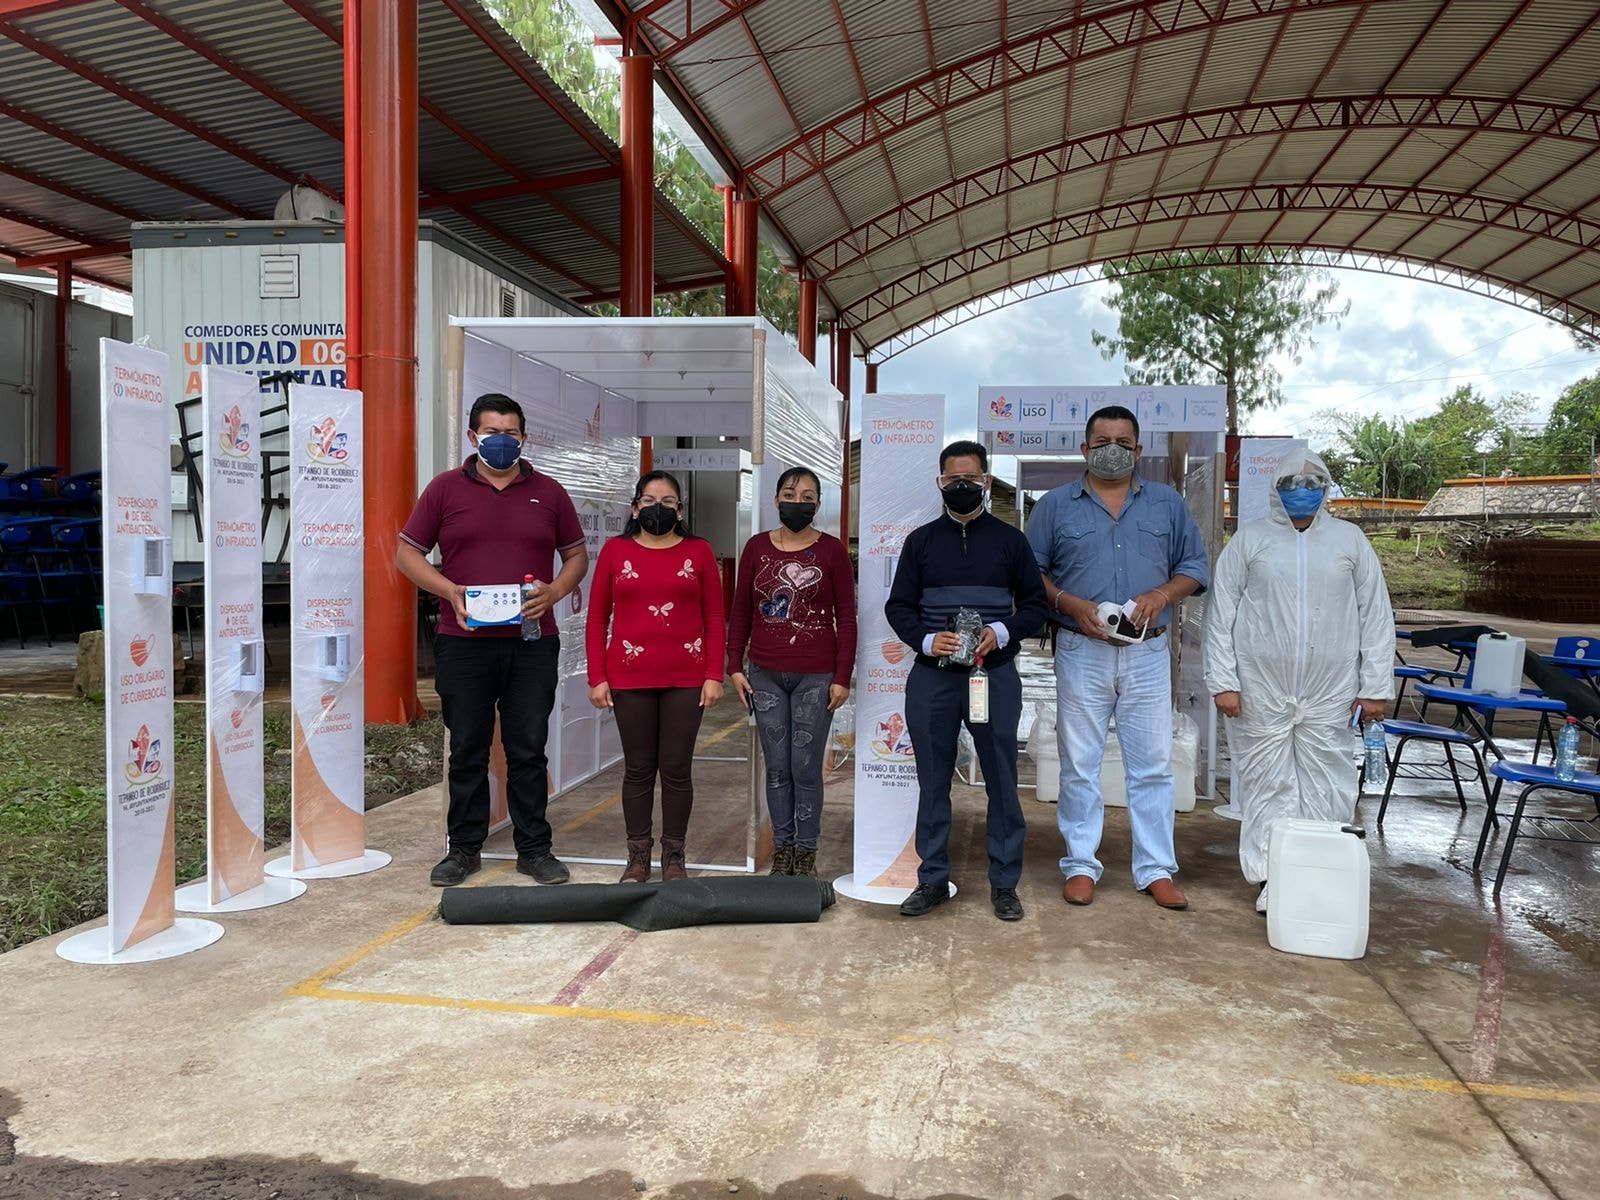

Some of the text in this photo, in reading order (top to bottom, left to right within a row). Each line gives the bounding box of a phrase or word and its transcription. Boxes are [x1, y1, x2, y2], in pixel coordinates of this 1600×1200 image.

[185, 323, 344, 338] COMEDORES COMUNITA
[184, 340, 346, 367] UNIDAD 06
[125, 386, 163, 404] INFRAROJO
[1139, 391, 1154, 402] 03
[1022, 407, 1047, 417] uso
[1193, 404, 1208, 417] 06
[884, 433, 935, 444] INFRAROJO
[231, 460, 237, 470] DE
[323, 467, 330, 476] DE
[311, 476, 354, 484] AYUNTAMIENTO
[117, 496, 160, 509] DISPENSADOR
[132, 510, 152, 522] DE GEL
[116, 523, 161, 535] ANTIBACTERIAL
[224, 536, 257, 548] INFRAROJO
[307, 597, 352, 608] DISPENSADOR
[219, 603, 255, 615] DISPENSADOR
[231, 615, 249, 625] DE GEL
[218, 626, 256, 638] ANTIBACTERIAL
[867, 668, 884, 678] USO
[121, 674, 133, 686] USO
[867, 682, 878, 692] DE
[121, 686, 167, 705] DE CUBREBOCAS
[320, 723, 353, 734] CUBREBOCAS
[862, 763, 888, 773] TEPANGO
[889, 764, 897, 773] DE
[881, 780, 910, 788] 2018-2021
[139, 787, 146, 799] DE
[129, 792, 166, 810] AYUNTAMIENTO
